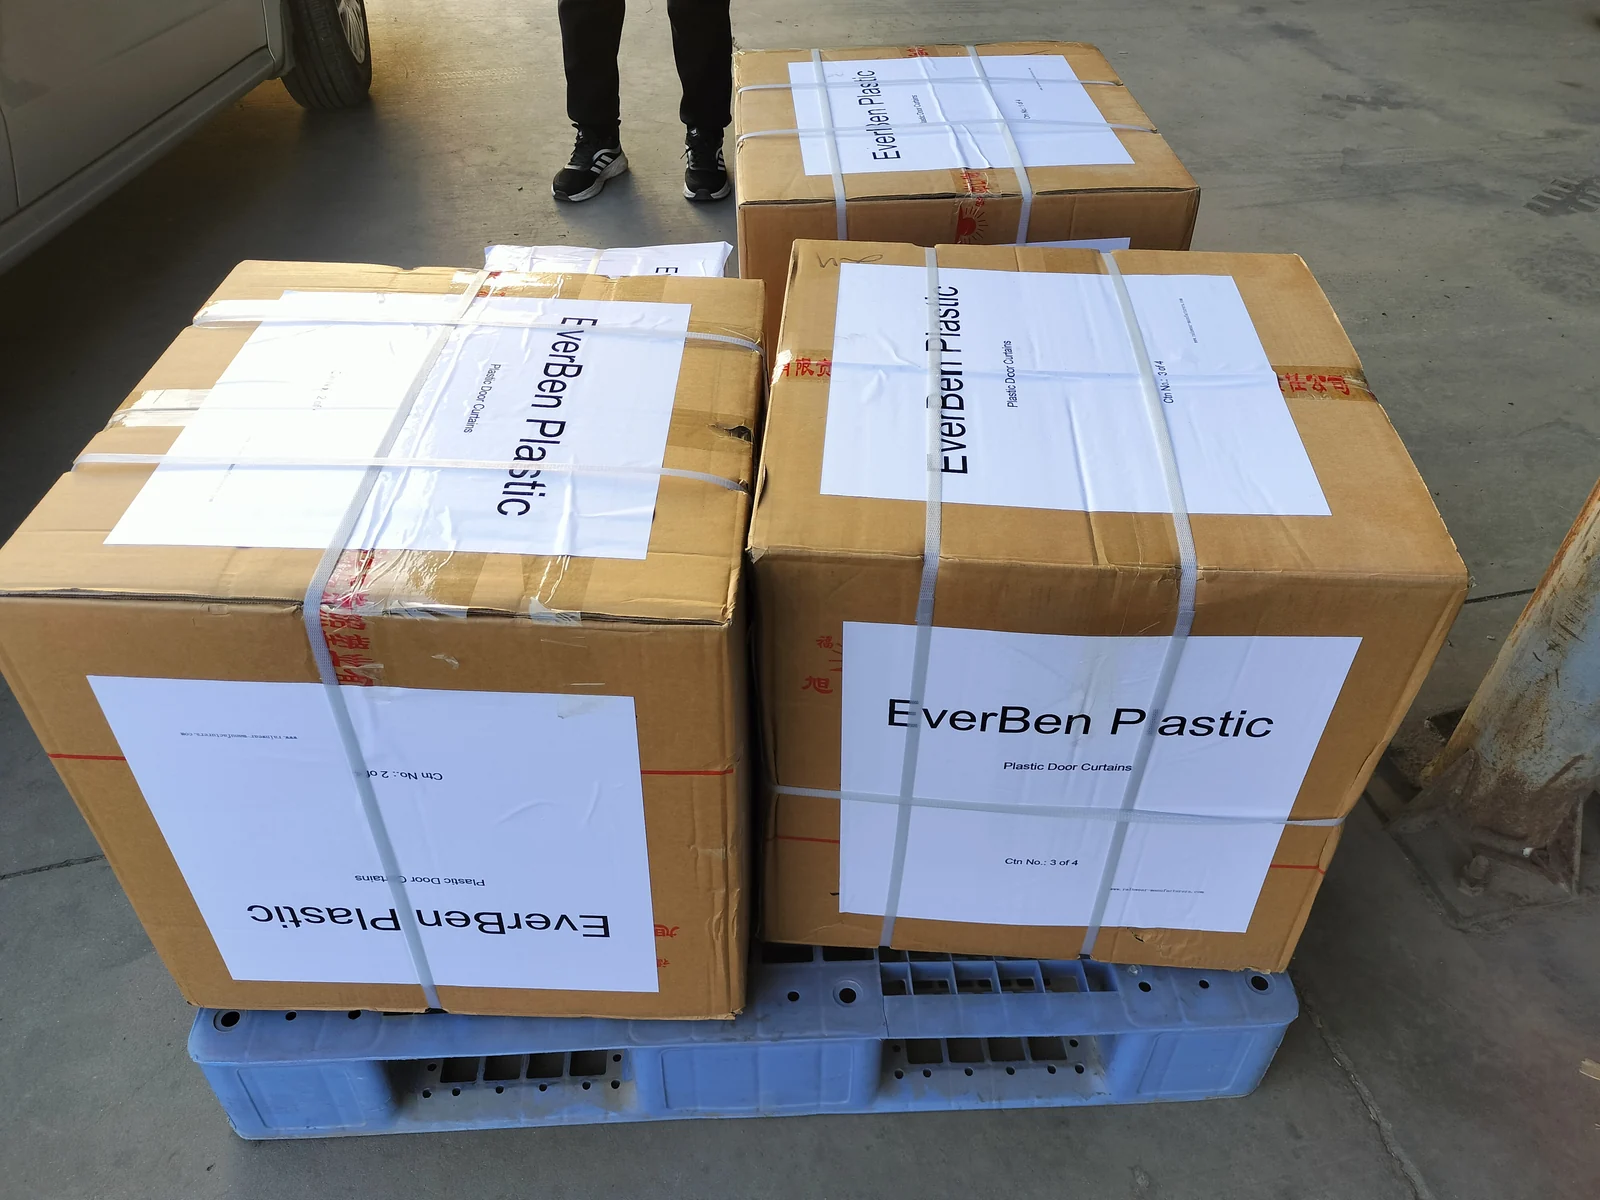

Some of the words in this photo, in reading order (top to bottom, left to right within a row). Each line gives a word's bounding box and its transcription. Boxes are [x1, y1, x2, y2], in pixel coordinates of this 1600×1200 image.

[852, 70, 884, 105] Plastic
[866, 108, 901, 160] EverBen
[925, 286, 962, 353] Plastic
[531, 316, 598, 409] EverBen
[1003, 340, 1014, 365] Curtains
[483, 363, 501, 385] Plastic
[1005, 366, 1016, 384] Door
[476, 385, 492, 403] Door
[1007, 384, 1018, 408] Plastic
[1163, 392, 1174, 404] Ctn
[464, 404, 485, 433] Curtains
[926, 362, 968, 474] EverBen
[497, 418, 566, 516] Plastic
[888, 698, 1092, 735] EverBen
[366, 770, 378, 778] of
[392, 771, 418, 780] No.:
[421, 772, 443, 780] Ctn
[1003, 762, 1044, 771] Plastic
[1048, 763, 1078, 771] Door
[1081, 763, 1133, 772] Curtains
[410, 876, 441, 885] Door
[444, 878, 485, 887] Plastic
[246, 904, 402, 931] Plastic
[416, 908, 611, 938] EverBen
